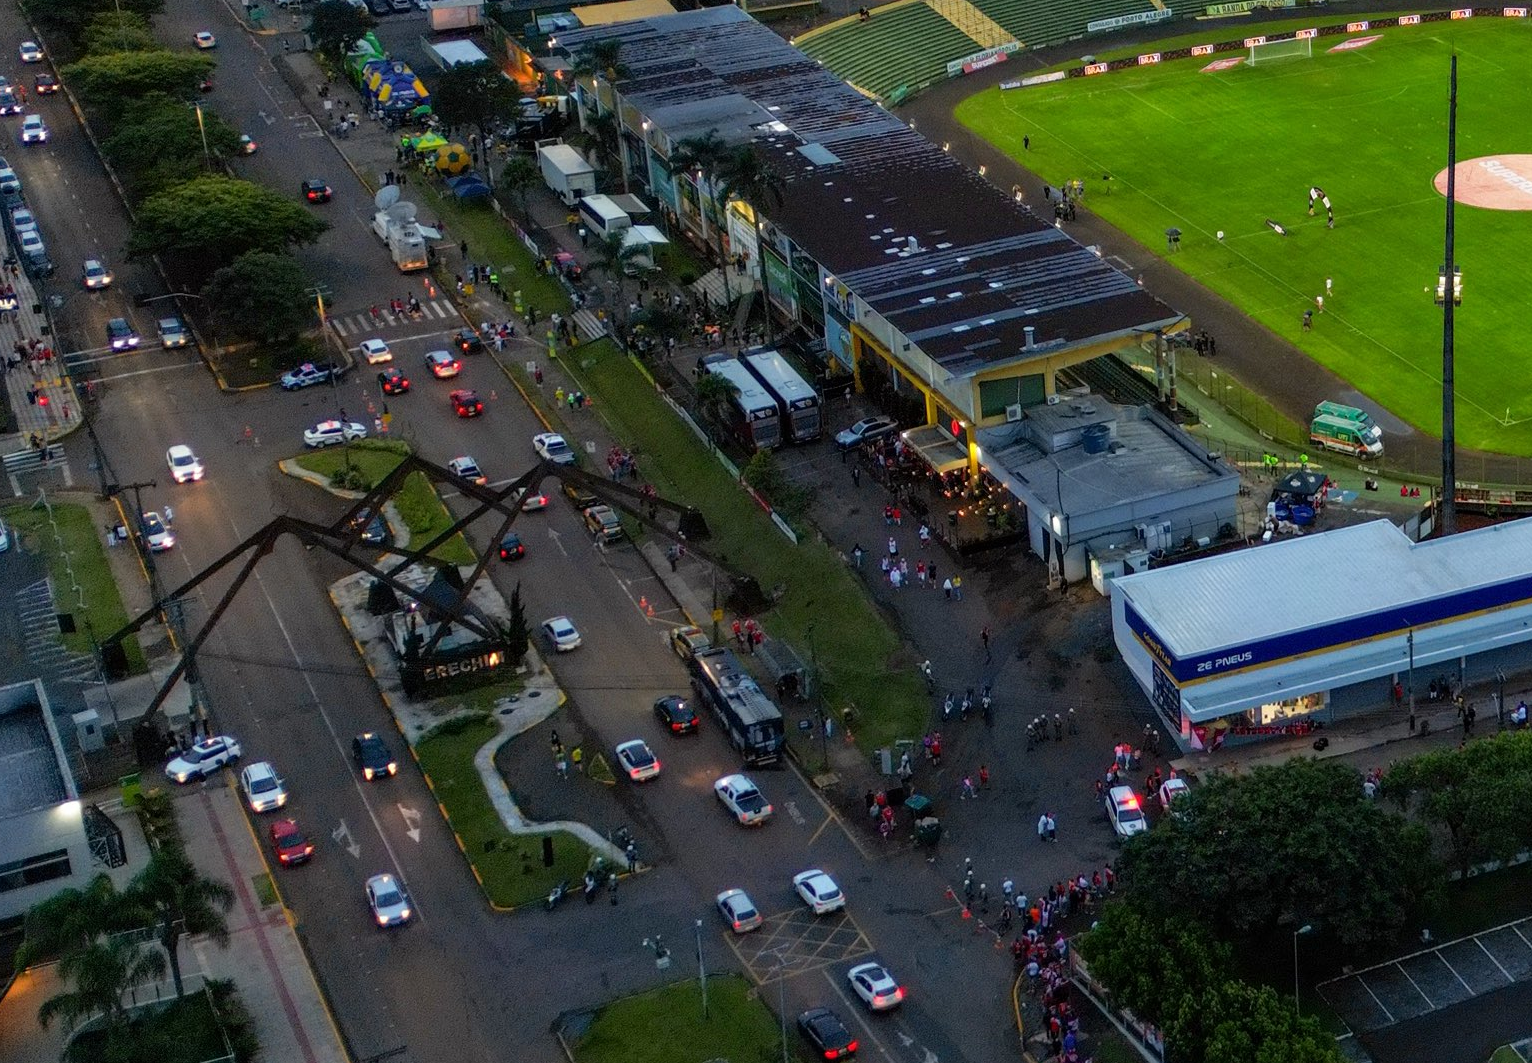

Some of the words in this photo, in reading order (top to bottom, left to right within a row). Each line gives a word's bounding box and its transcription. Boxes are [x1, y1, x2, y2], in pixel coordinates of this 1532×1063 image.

[1121, 14, 1143, 24] PORTO
[1145, 10, 1171, 19] ALEGRE
[423, 651, 505, 681] ERECHIM
[1215, 651, 1253, 668] PNEUS
